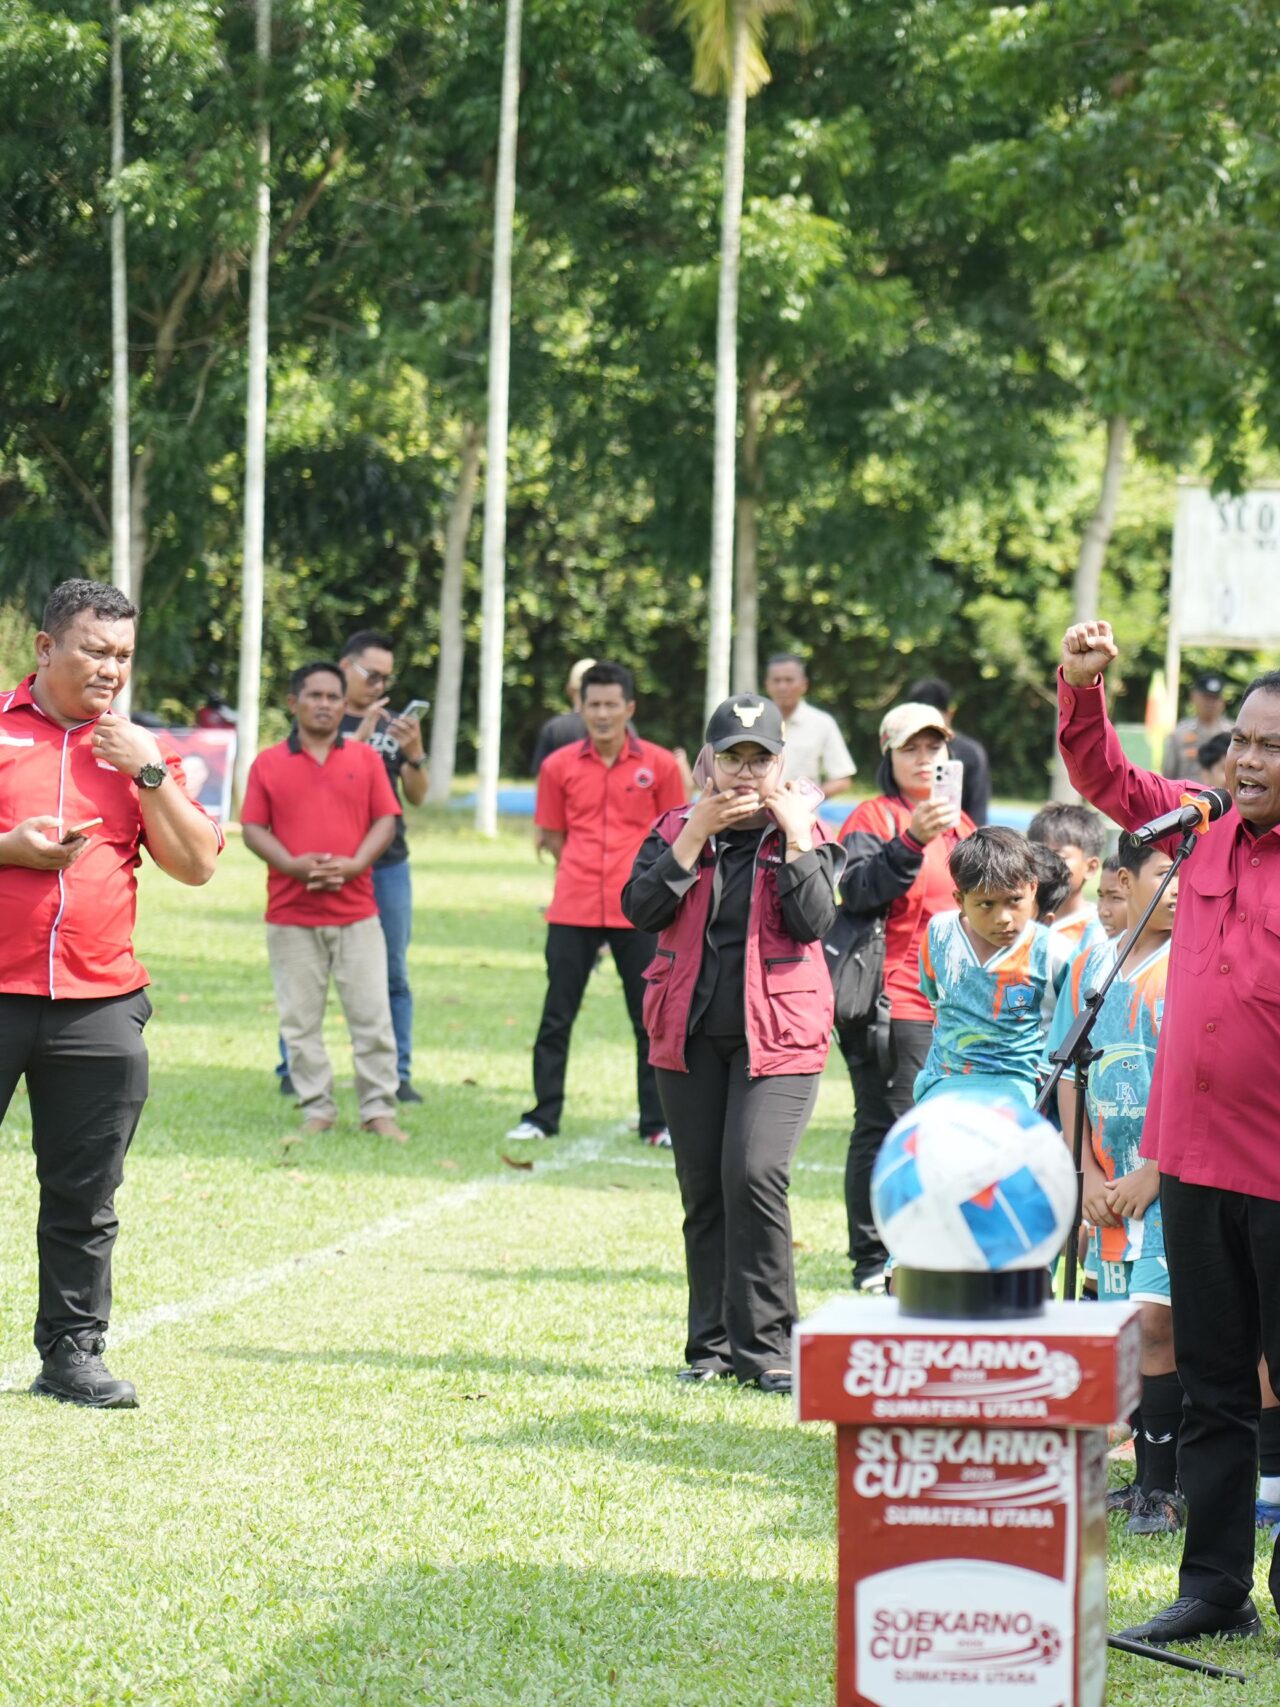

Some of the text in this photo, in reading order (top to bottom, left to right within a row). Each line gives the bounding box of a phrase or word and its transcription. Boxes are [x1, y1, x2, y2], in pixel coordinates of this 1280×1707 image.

[1101, 1260, 1127, 1294] 18
[849, 1339, 1048, 1369] SOEKARNO
[843, 1367, 928, 1397] CUP
[873, 1400, 1048, 1418] SUMATERA UTARA
[856, 1427, 1063, 1466] SOEKARNO
[853, 1461, 939, 1499] CUP
[884, 1506, 1054, 1529] SUMATERA UTARA
[872, 1609, 1033, 1635] SOEKARNO
[870, 1634, 933, 1661] CUP
[894, 1667, 1038, 1685] SUMATERA UTARA
